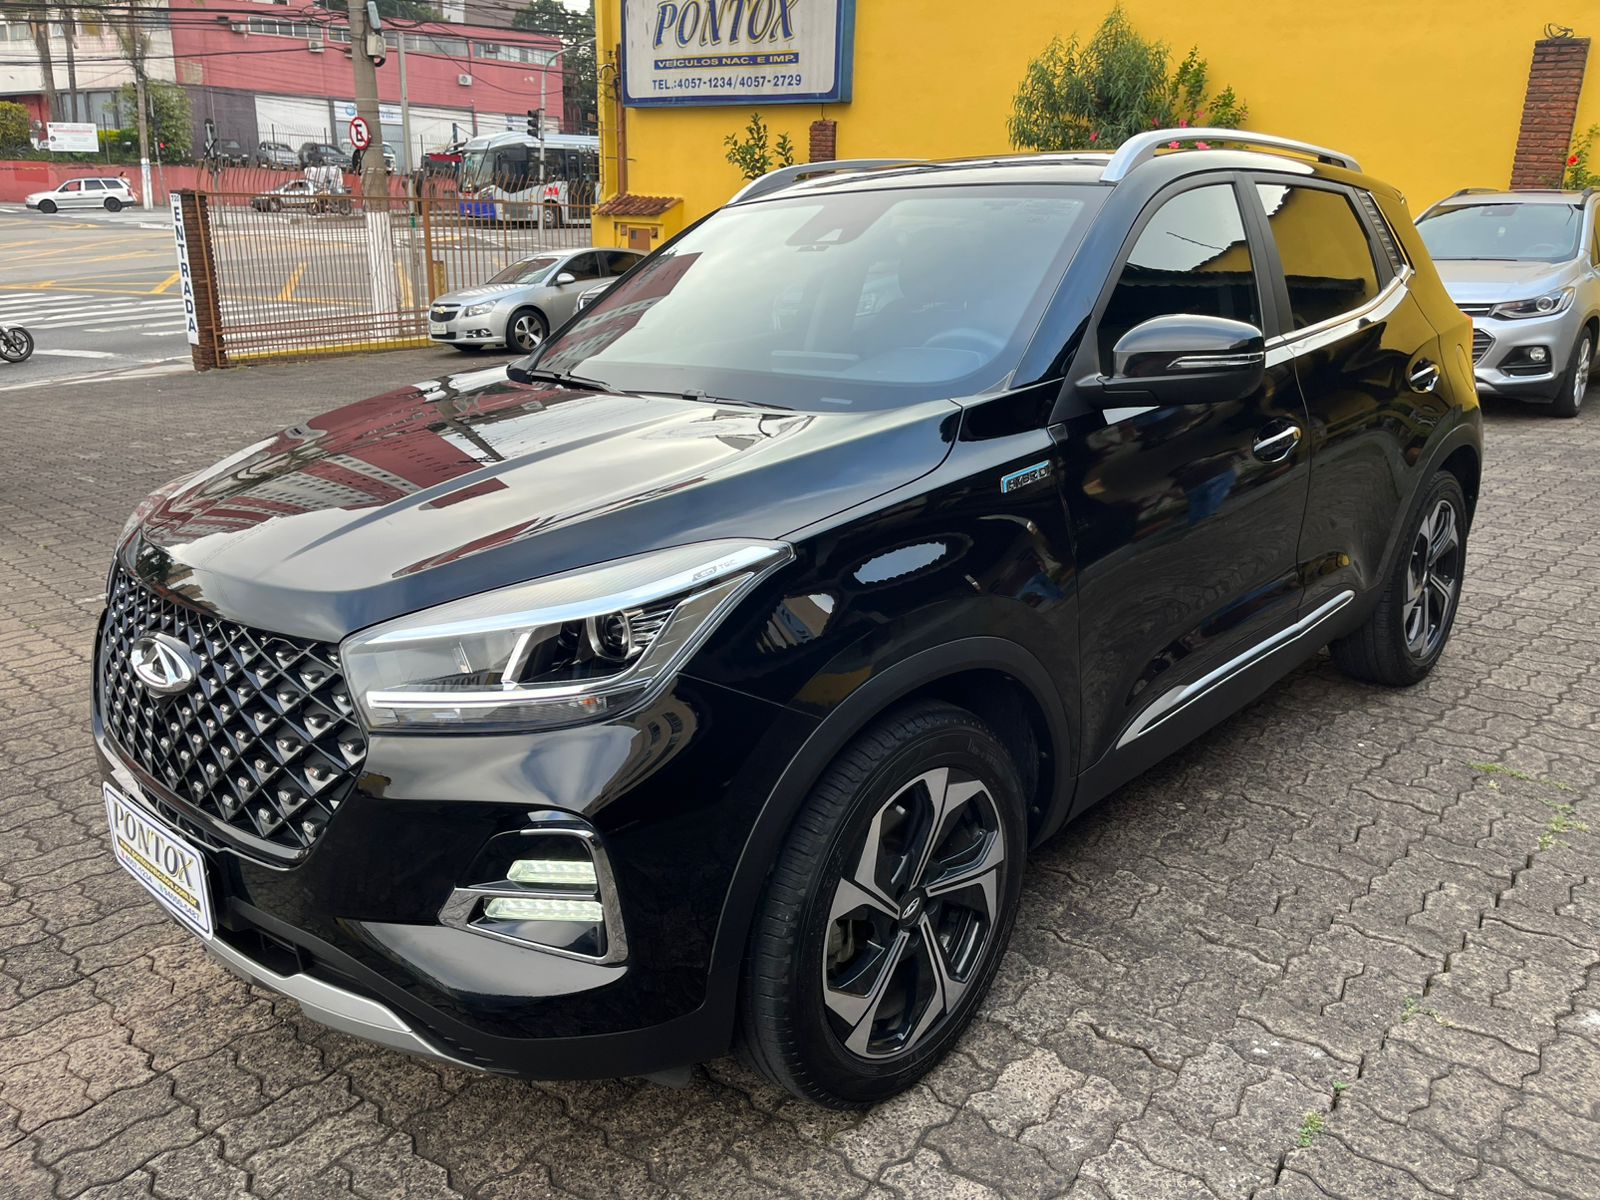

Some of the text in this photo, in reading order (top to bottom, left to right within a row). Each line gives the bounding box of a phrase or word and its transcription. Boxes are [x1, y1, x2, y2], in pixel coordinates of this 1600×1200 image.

[653, 0, 800, 50] PONTOX
[722, 56, 753, 65] NAC.
[757, 56, 766, 64] E
[769, 54, 796, 63] IMP.
[173, 206, 197, 333] ENTRADA
[113, 800, 195, 891] PONTOX
